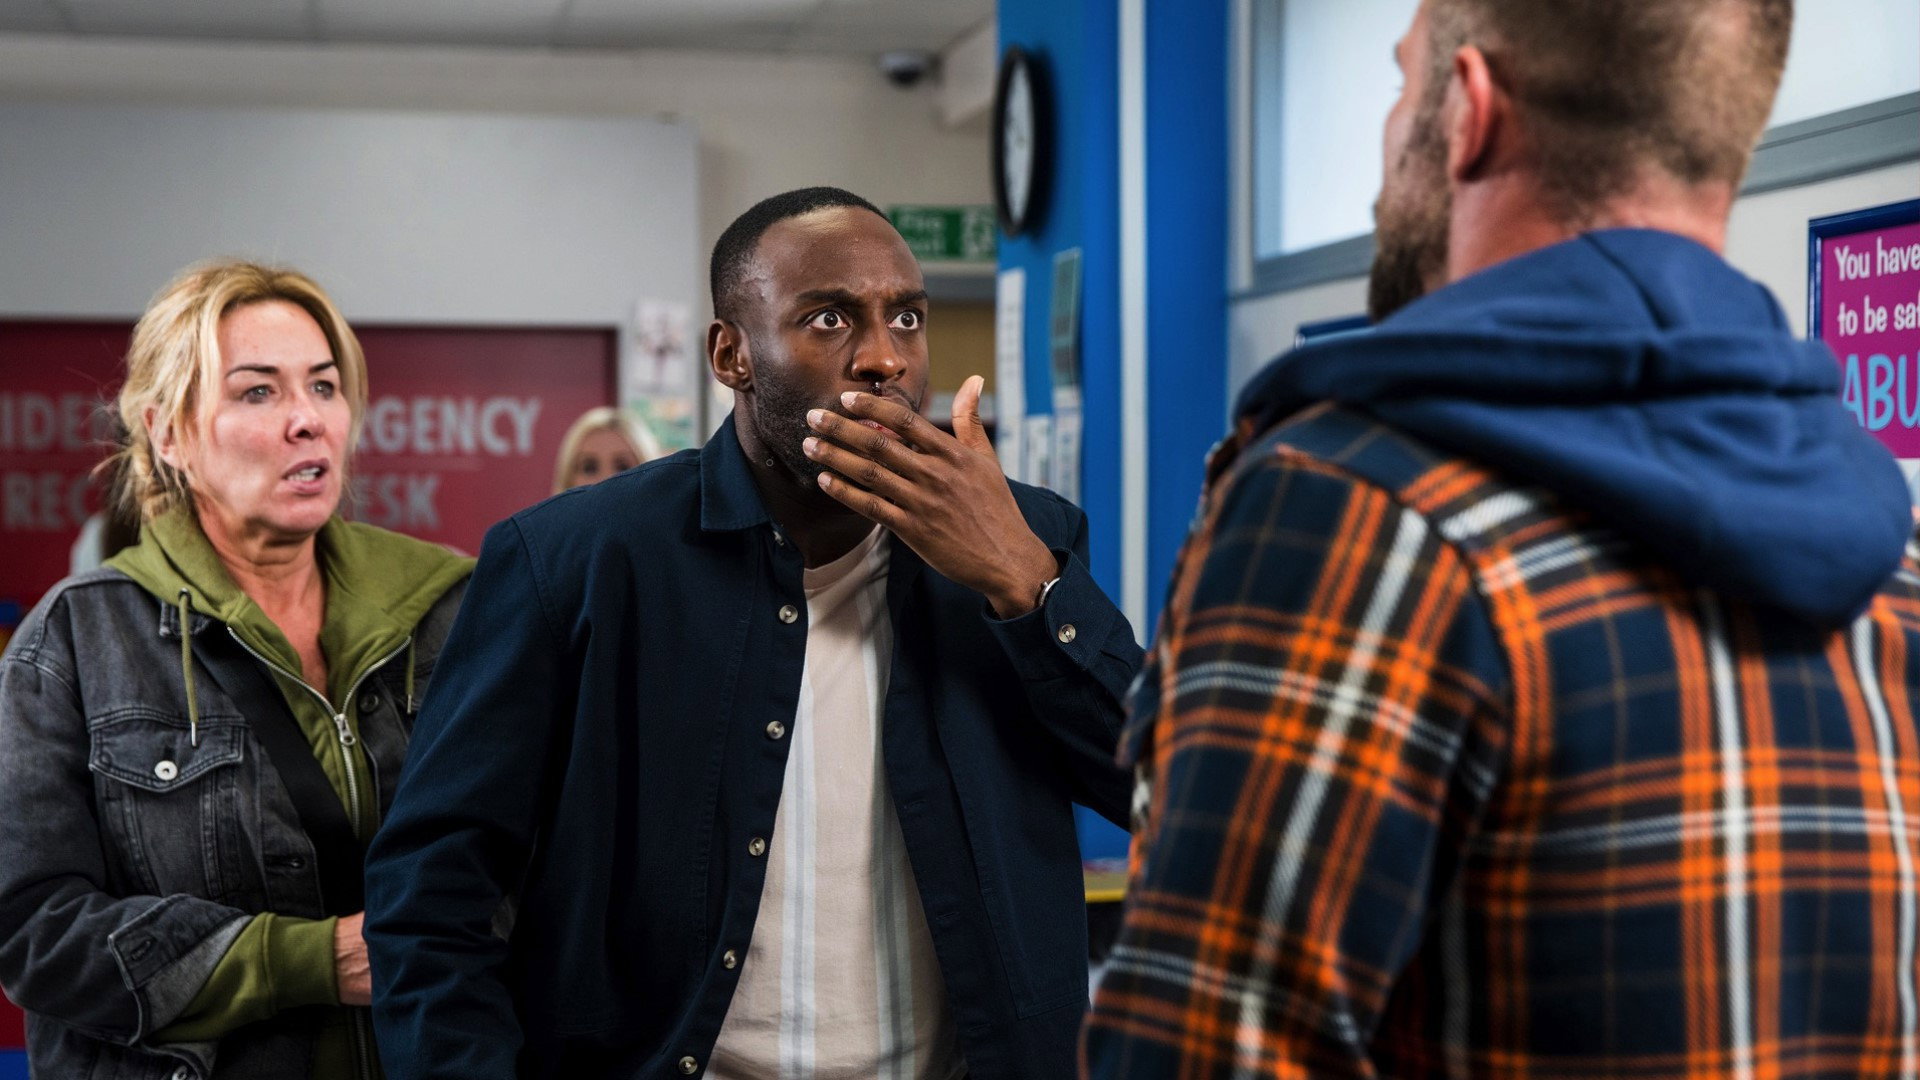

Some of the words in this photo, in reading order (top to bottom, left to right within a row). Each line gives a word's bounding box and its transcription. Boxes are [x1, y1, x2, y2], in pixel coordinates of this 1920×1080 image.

[1834, 245, 1870, 280] You
[1877, 236, 1920, 276] have
[1838, 302, 1858, 336] to
[1864, 295, 1887, 334] be
[1842, 354, 1920, 430] ABU
[0, 394, 108, 450] IDE
[4, 473, 104, 529] REC
[342, 475, 439, 529] ESK
